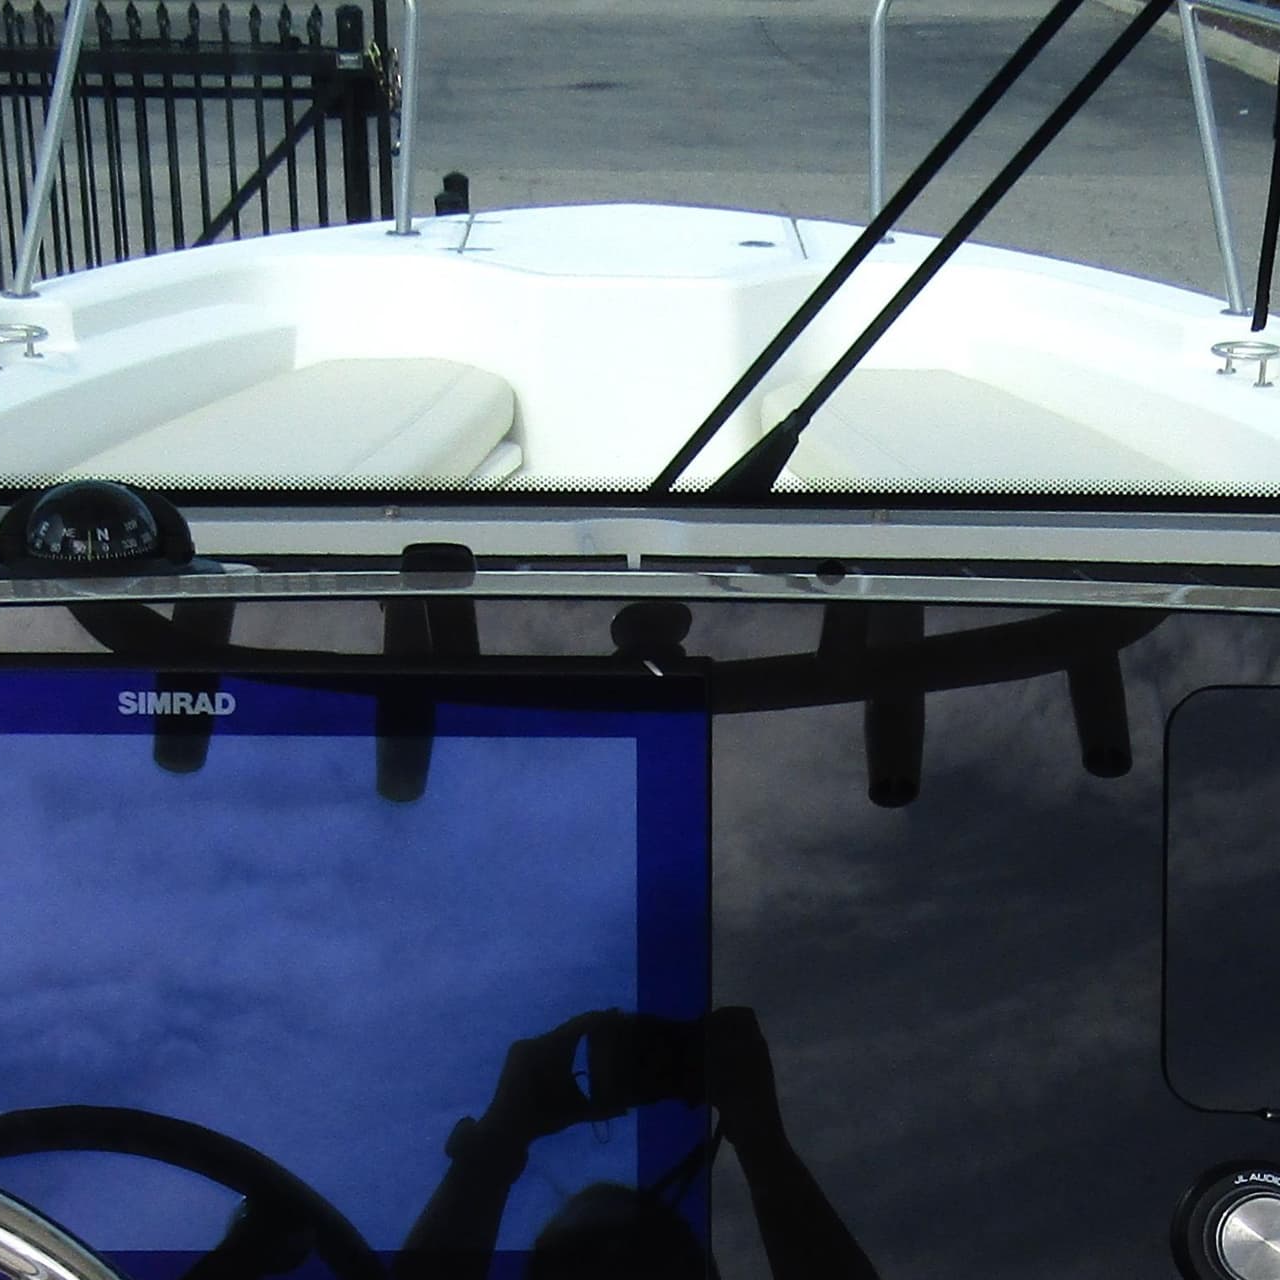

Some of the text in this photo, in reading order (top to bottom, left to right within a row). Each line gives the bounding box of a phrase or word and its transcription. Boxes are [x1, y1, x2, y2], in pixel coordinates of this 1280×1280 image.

[96, 527, 110, 542] N
[118, 691, 236, 715] SIMRAD
[1234, 1174, 1248, 1185] JL
